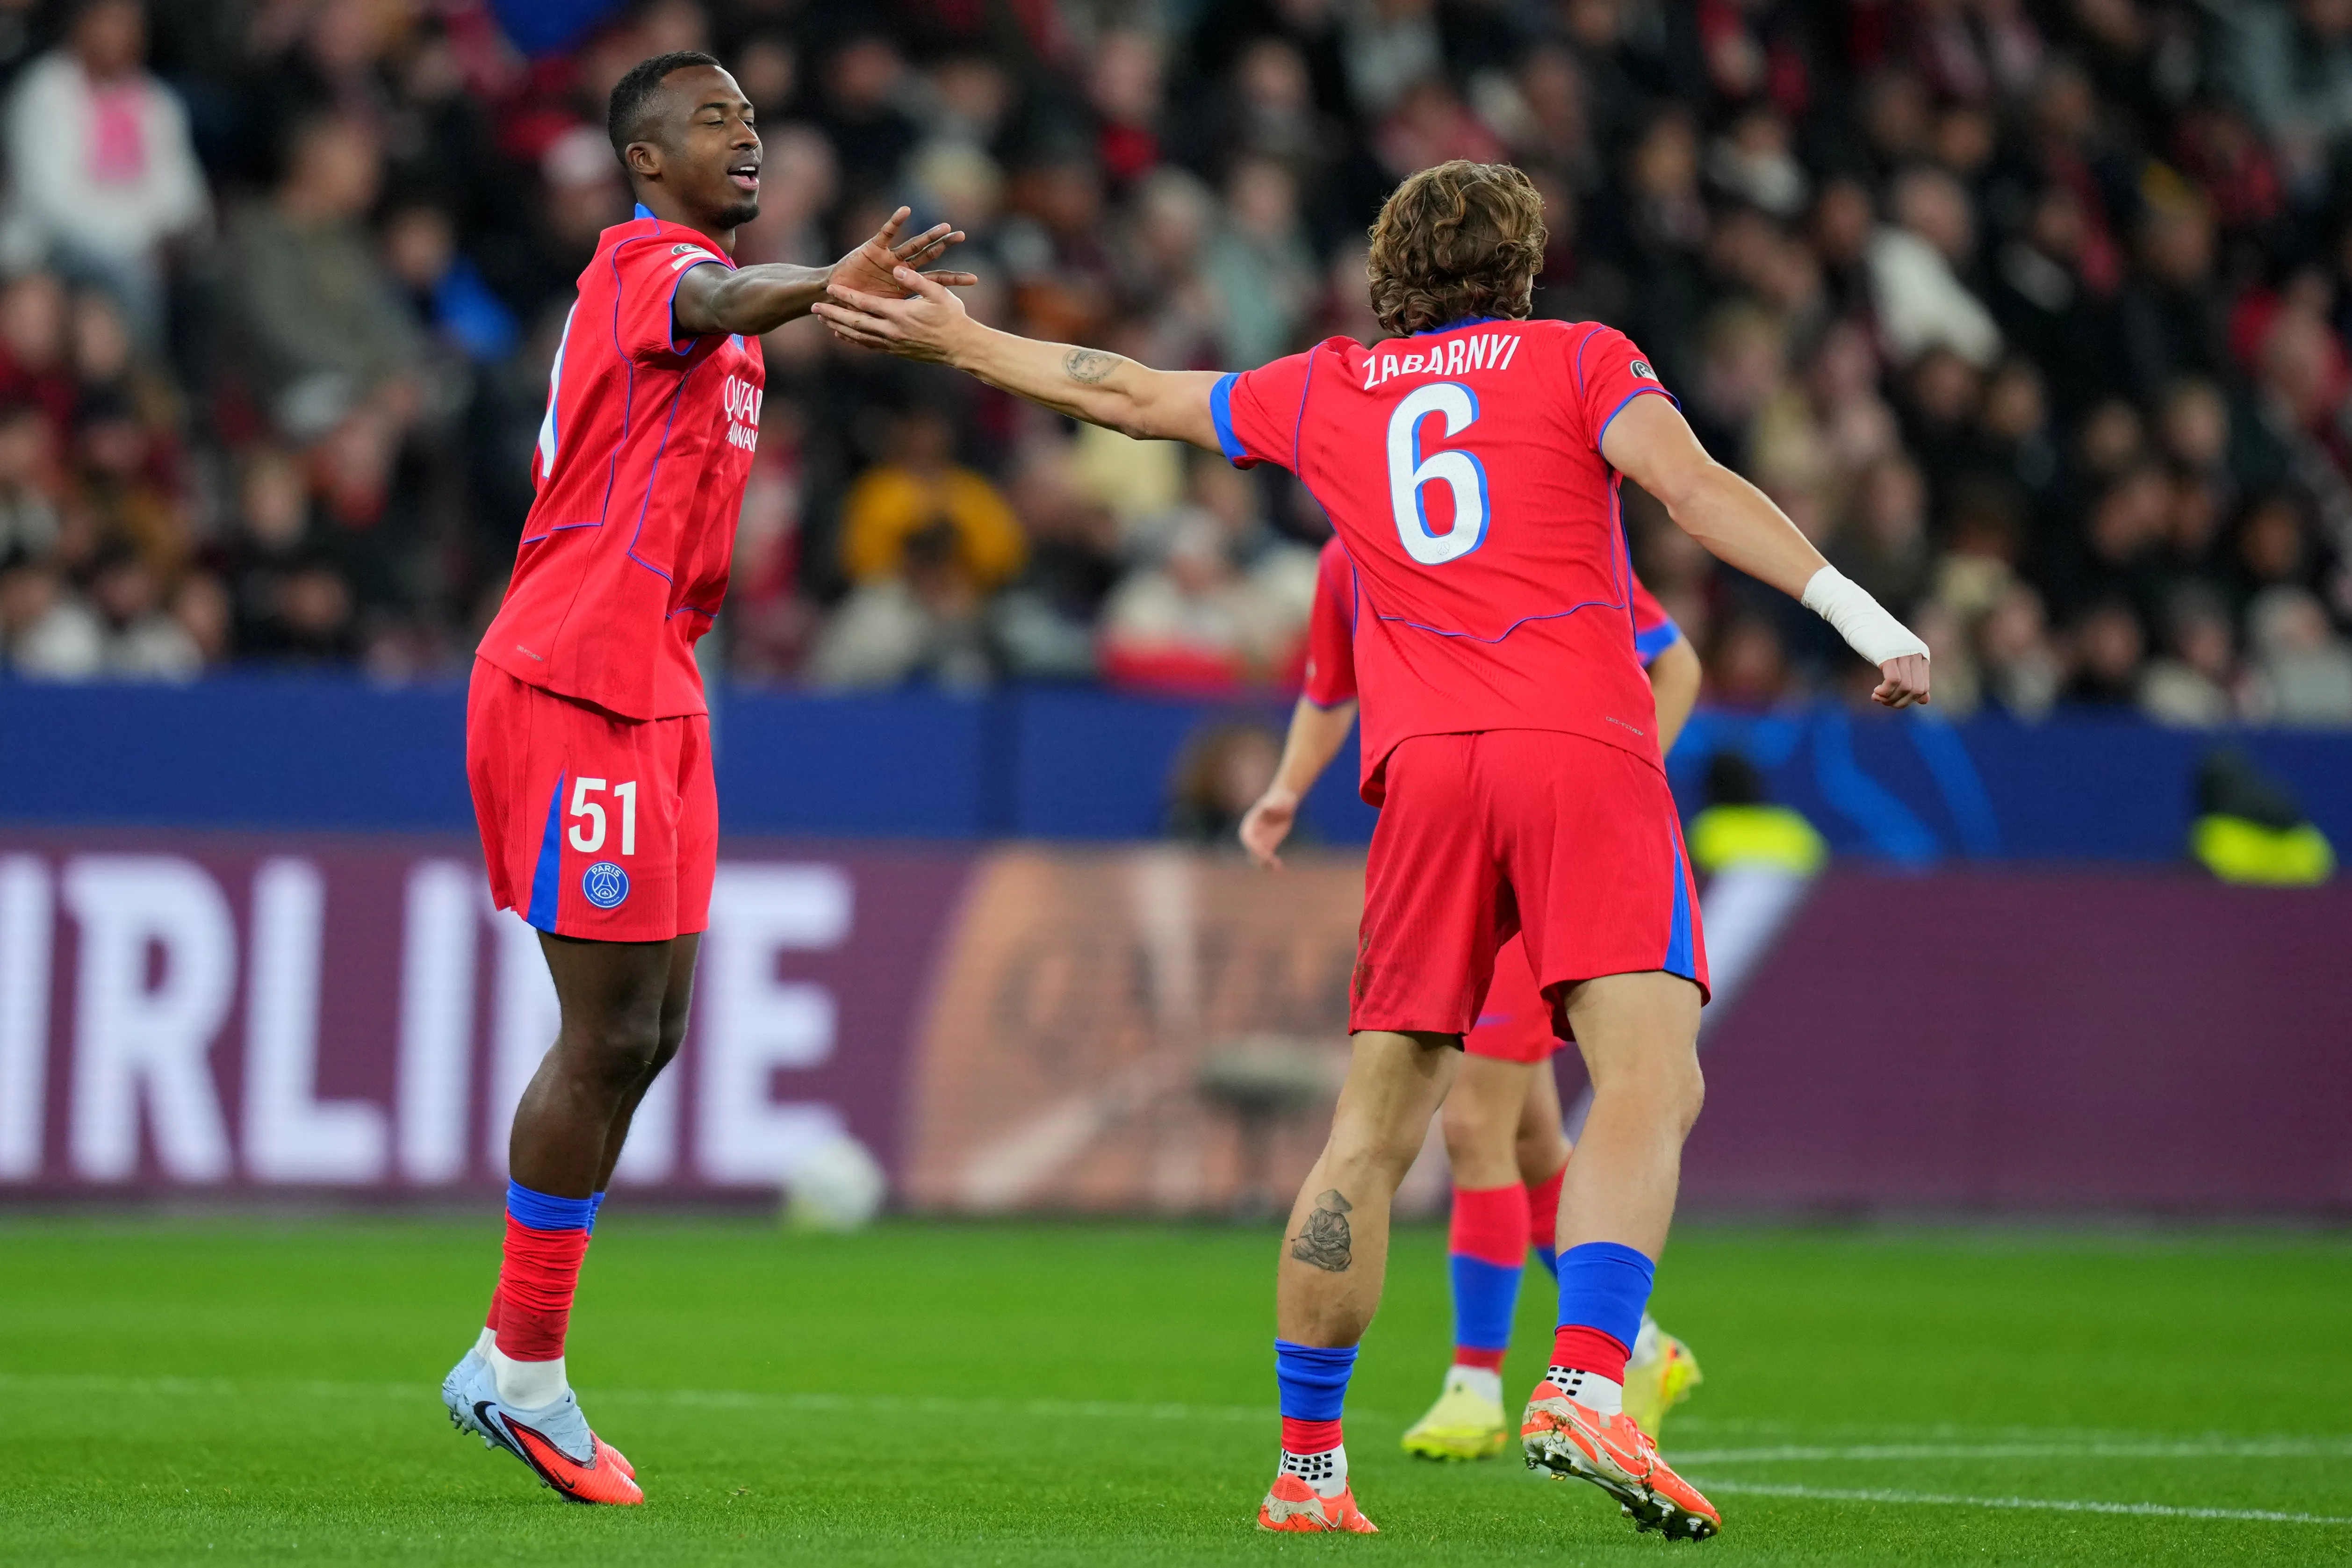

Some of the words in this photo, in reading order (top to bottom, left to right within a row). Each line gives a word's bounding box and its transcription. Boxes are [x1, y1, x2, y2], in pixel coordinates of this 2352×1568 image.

[1362, 334, 1521, 391] ZABARNYI
[725, 374, 763, 426] QATAR
[1386, 381, 1491, 566] 6
[568, 777, 636, 856] 51
[591, 865, 621, 878] PARIS
